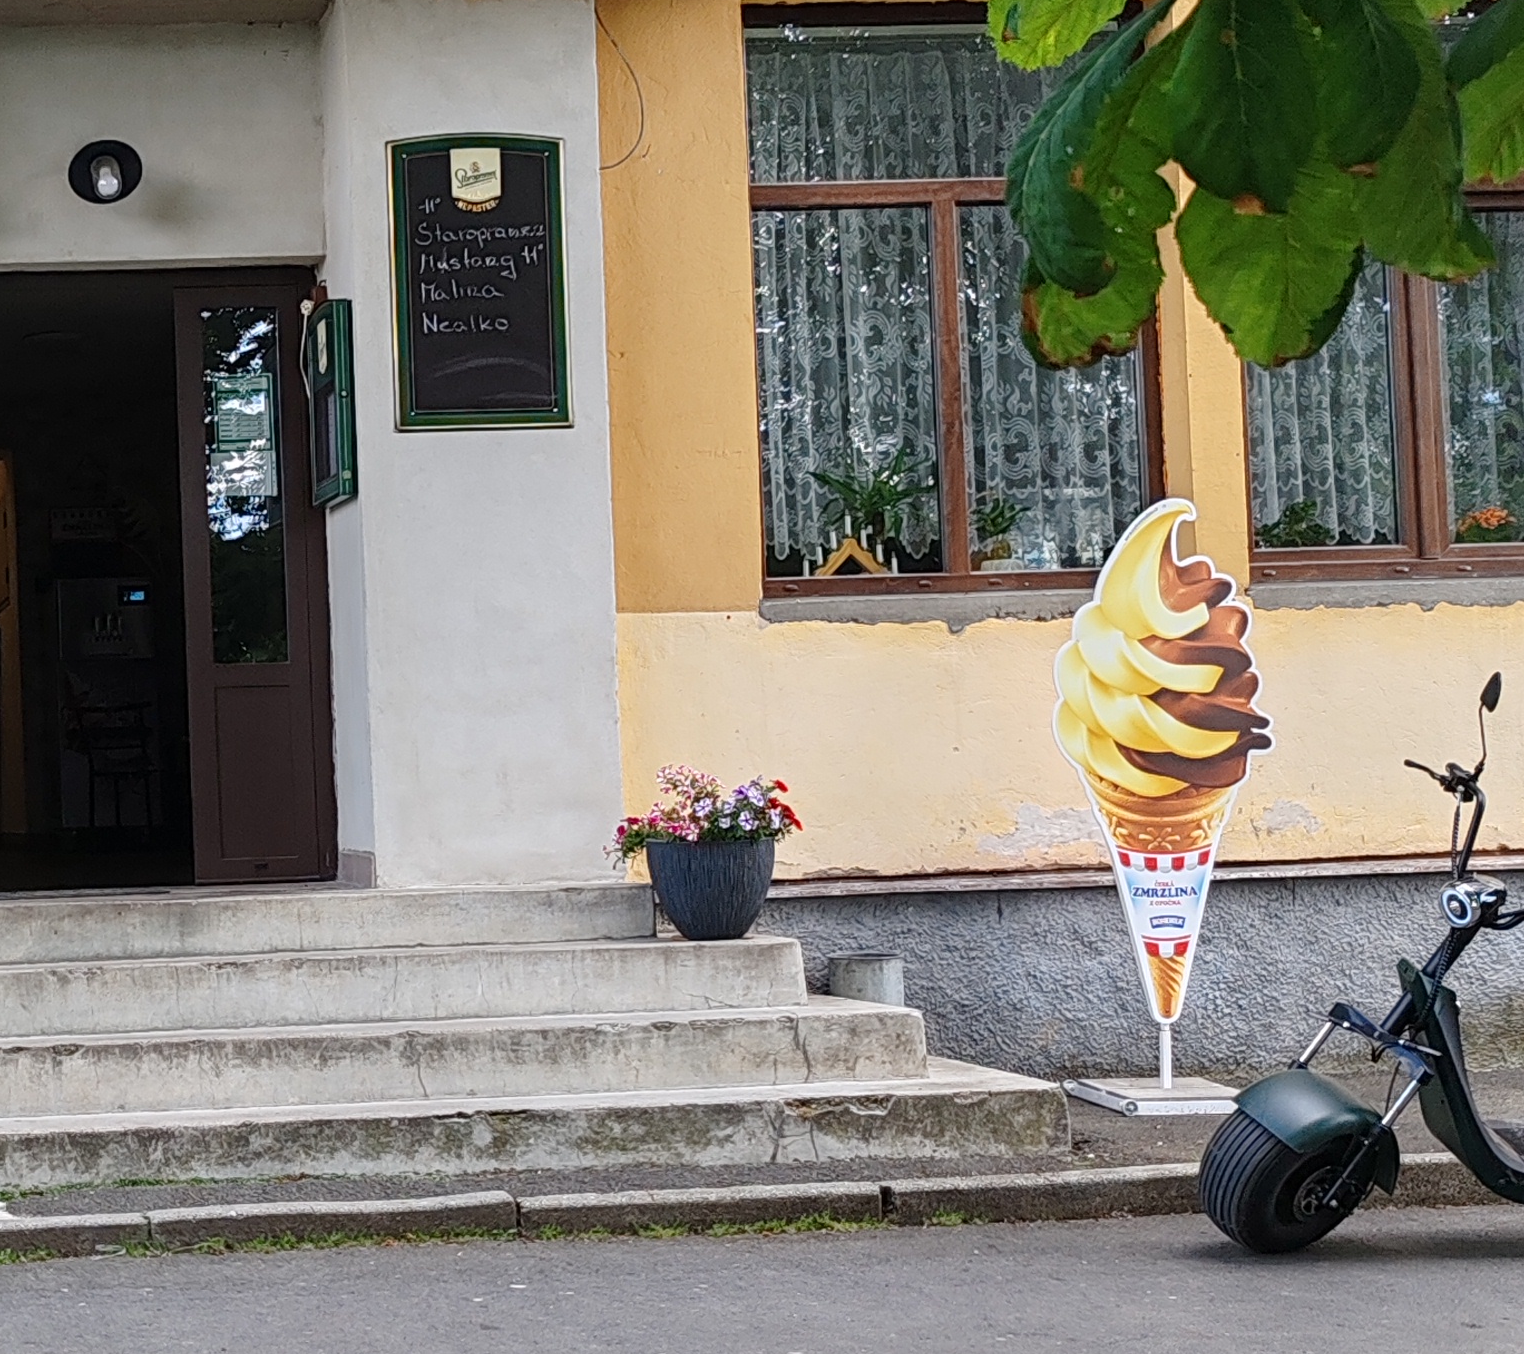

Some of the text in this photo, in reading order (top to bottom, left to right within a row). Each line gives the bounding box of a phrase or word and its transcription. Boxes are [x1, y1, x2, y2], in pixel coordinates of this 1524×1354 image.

[420, 278, 504, 304] Malina
[422, 312, 510, 334] Nealko
[1132, 885, 1198, 899] ZMRZLINA
